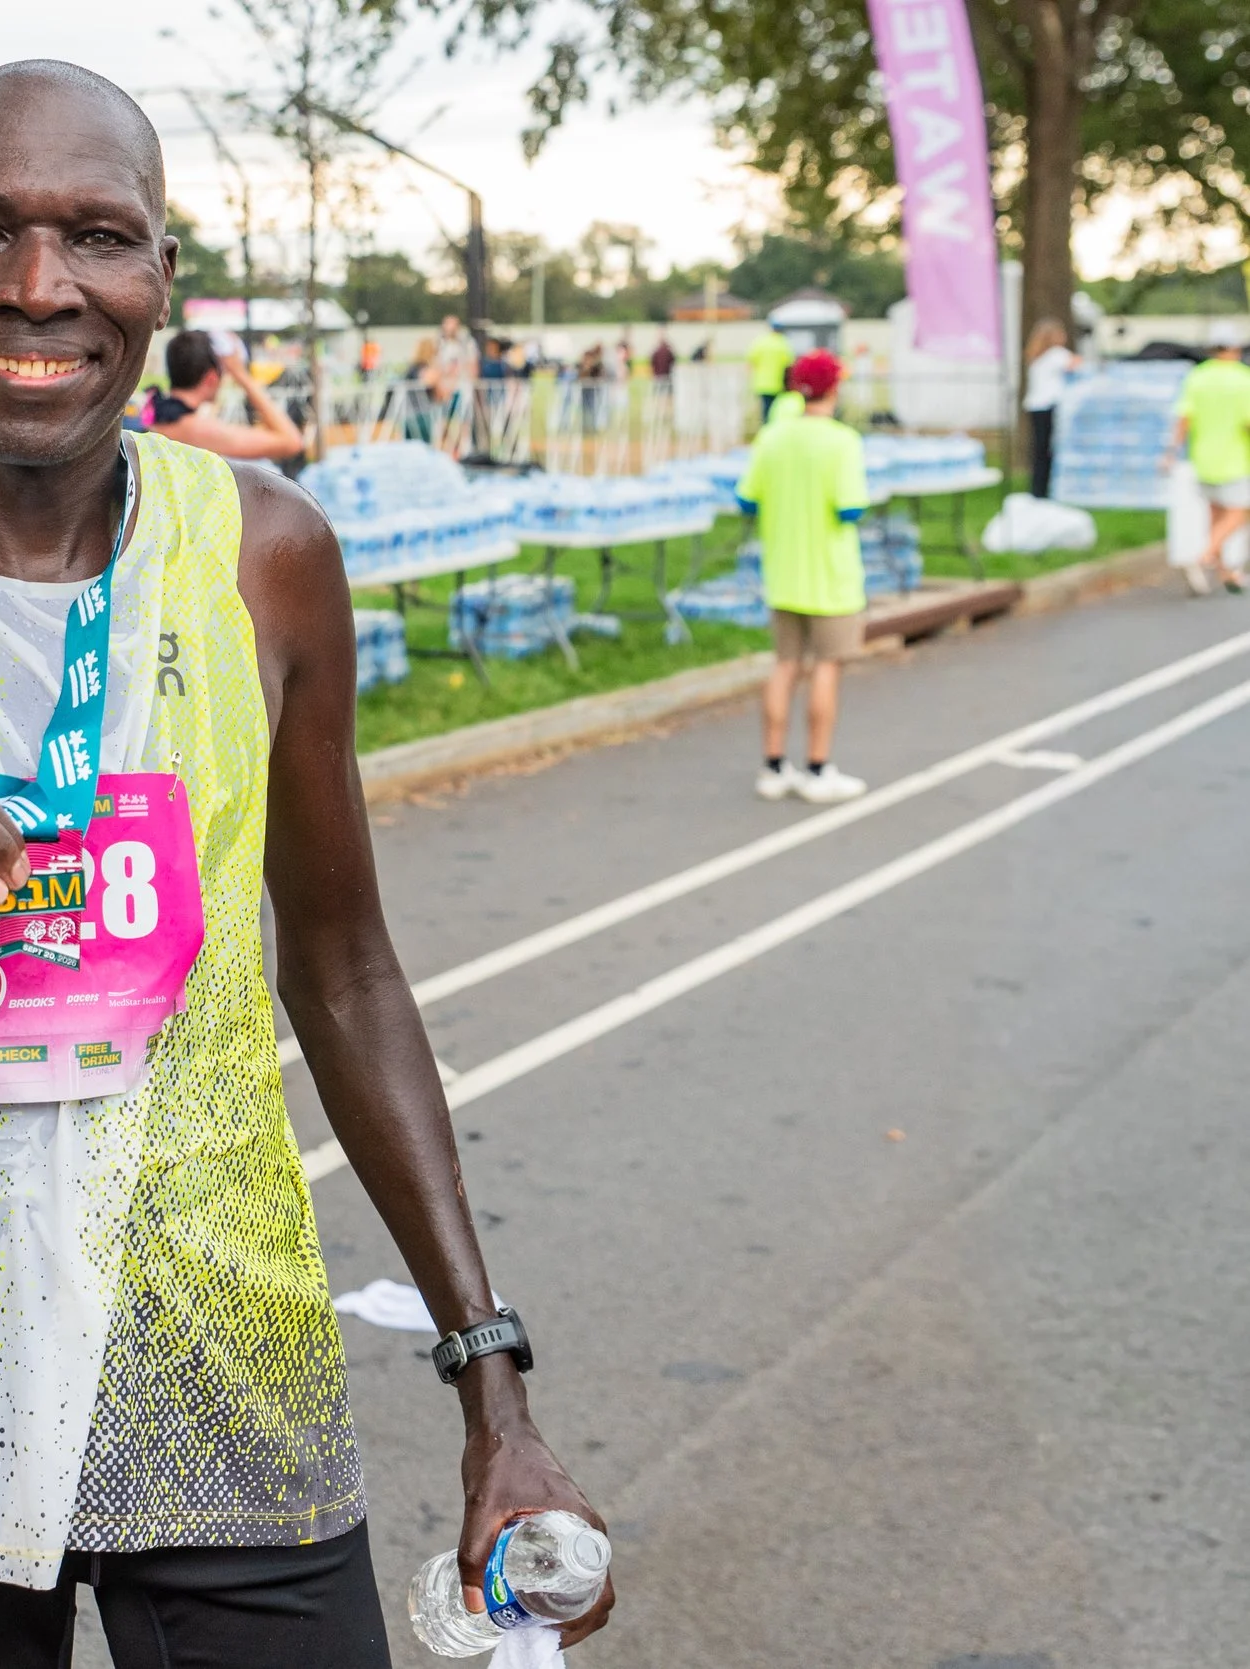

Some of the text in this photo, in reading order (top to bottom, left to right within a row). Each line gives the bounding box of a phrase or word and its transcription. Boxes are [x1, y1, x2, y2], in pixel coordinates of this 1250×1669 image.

[22, 944, 42, 955] SEPT
[8, 996, 57, 1009] BROOKS
[66, 993, 100, 1005] pacers
[109, 998, 141, 1008] MedStar
[142, 995, 167, 1005] Health
[78, 1043, 108, 1055] FREE
[81, 1053, 120, 1068] DRINK
[95, 1066, 116, 1076] ONLY
